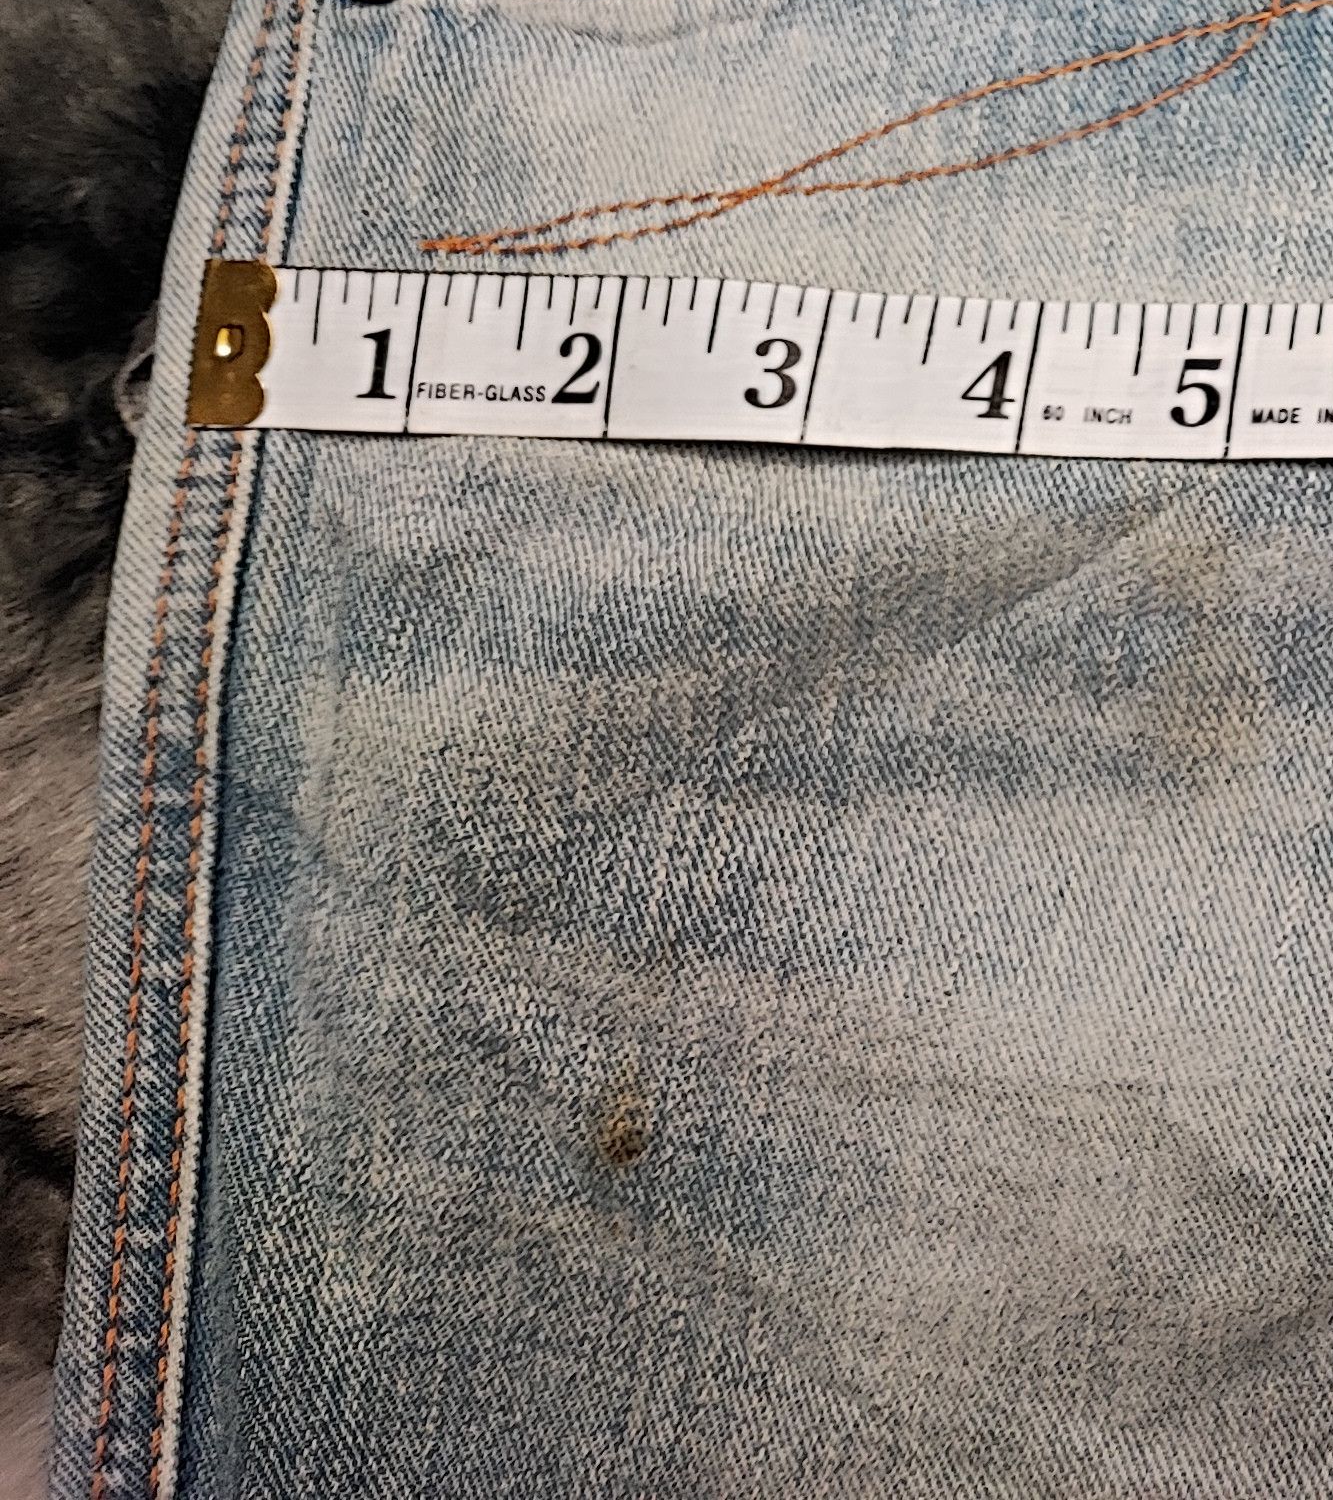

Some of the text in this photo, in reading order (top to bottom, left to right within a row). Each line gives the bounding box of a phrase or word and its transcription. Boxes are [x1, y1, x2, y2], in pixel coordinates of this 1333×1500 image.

[356, 329, 398, 400] 1
[551, 332, 600, 404] 2
[744, 339, 801, 409] 3
[961, 351, 1016, 419] 4
[1171, 359, 1222, 427] 5
[416, 382, 546, 403] FIBER-GLASS
[1083, 406, 1132, 425] INCH
[1252, 407, 1301, 424] MADE
